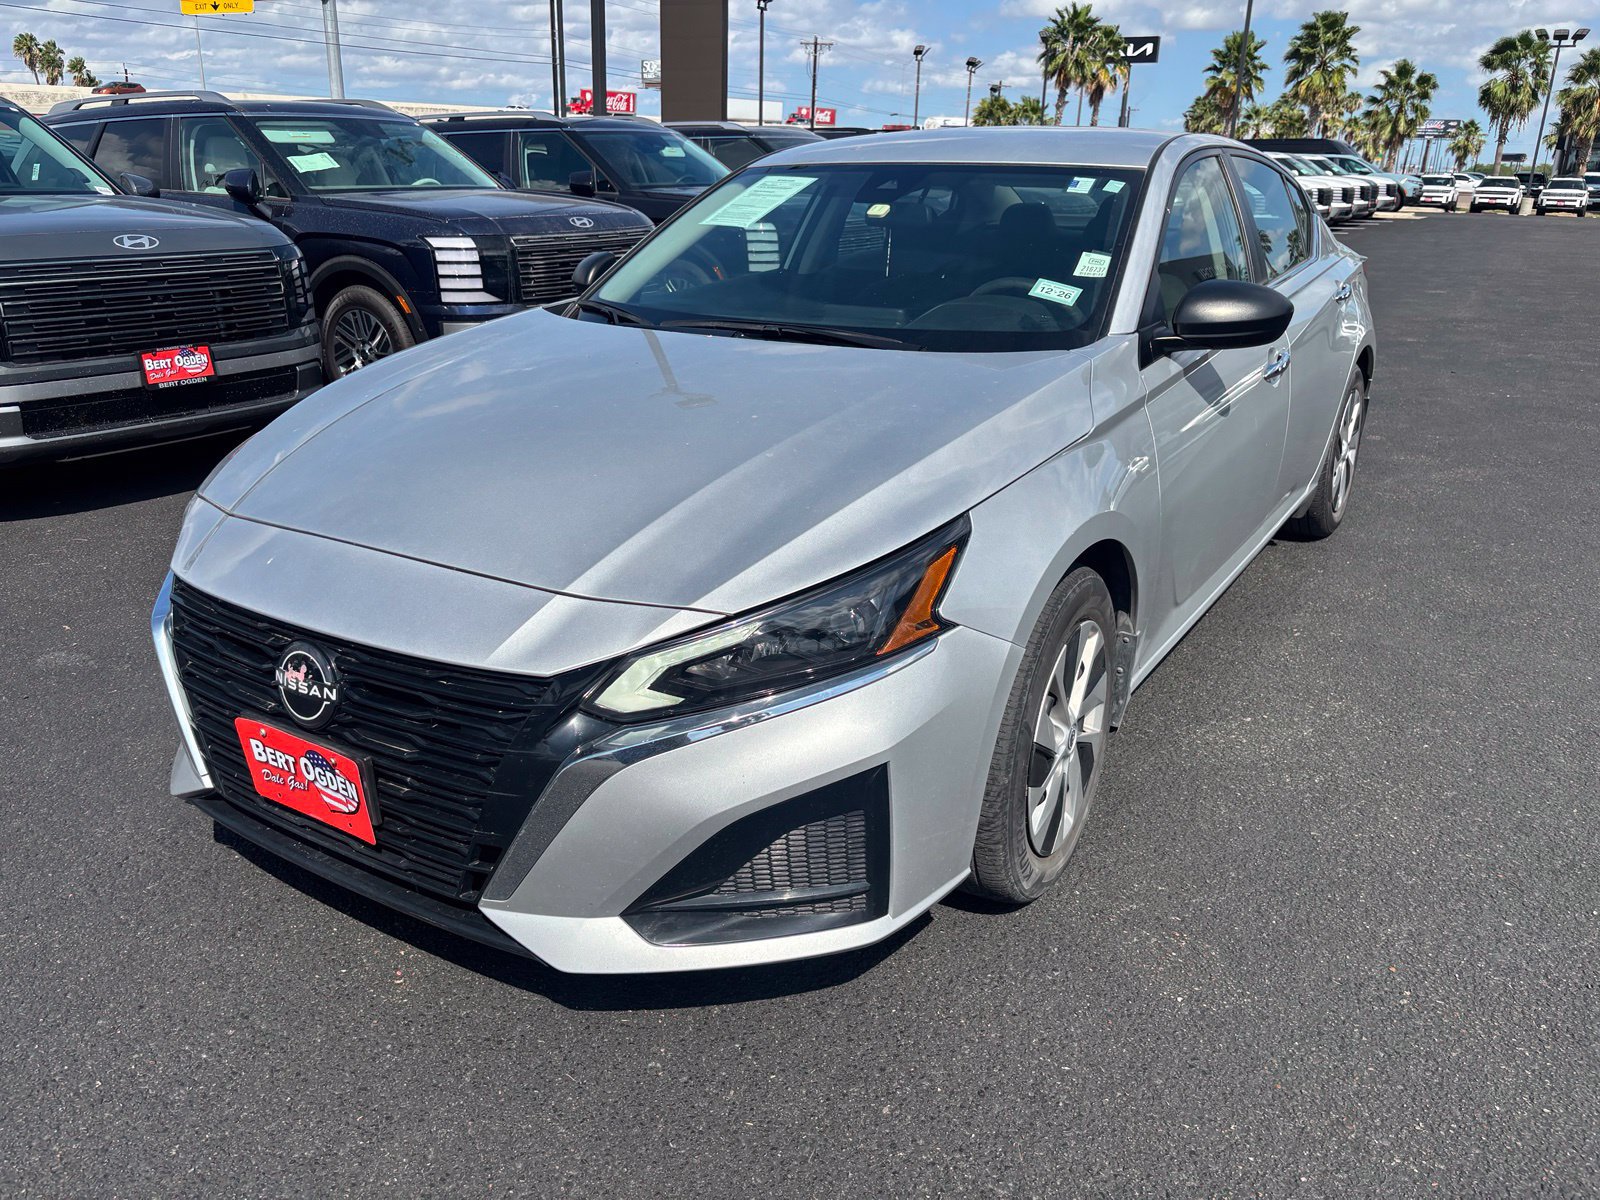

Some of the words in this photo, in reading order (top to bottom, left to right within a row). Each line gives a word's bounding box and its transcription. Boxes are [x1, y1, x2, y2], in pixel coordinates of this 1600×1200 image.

[144, 358, 172, 371] BERT
[174, 354, 208, 367] OGDEN
[159, 381, 179, 389] BERT
[180, 377, 208, 386] OGDEN
[275, 669, 337, 701] NISSAN
[249, 738, 296, 774] BERT
[299, 756, 359, 802] OGDEN
[261, 768, 285, 785] Dale
[287, 776, 308, 791] Gas!
